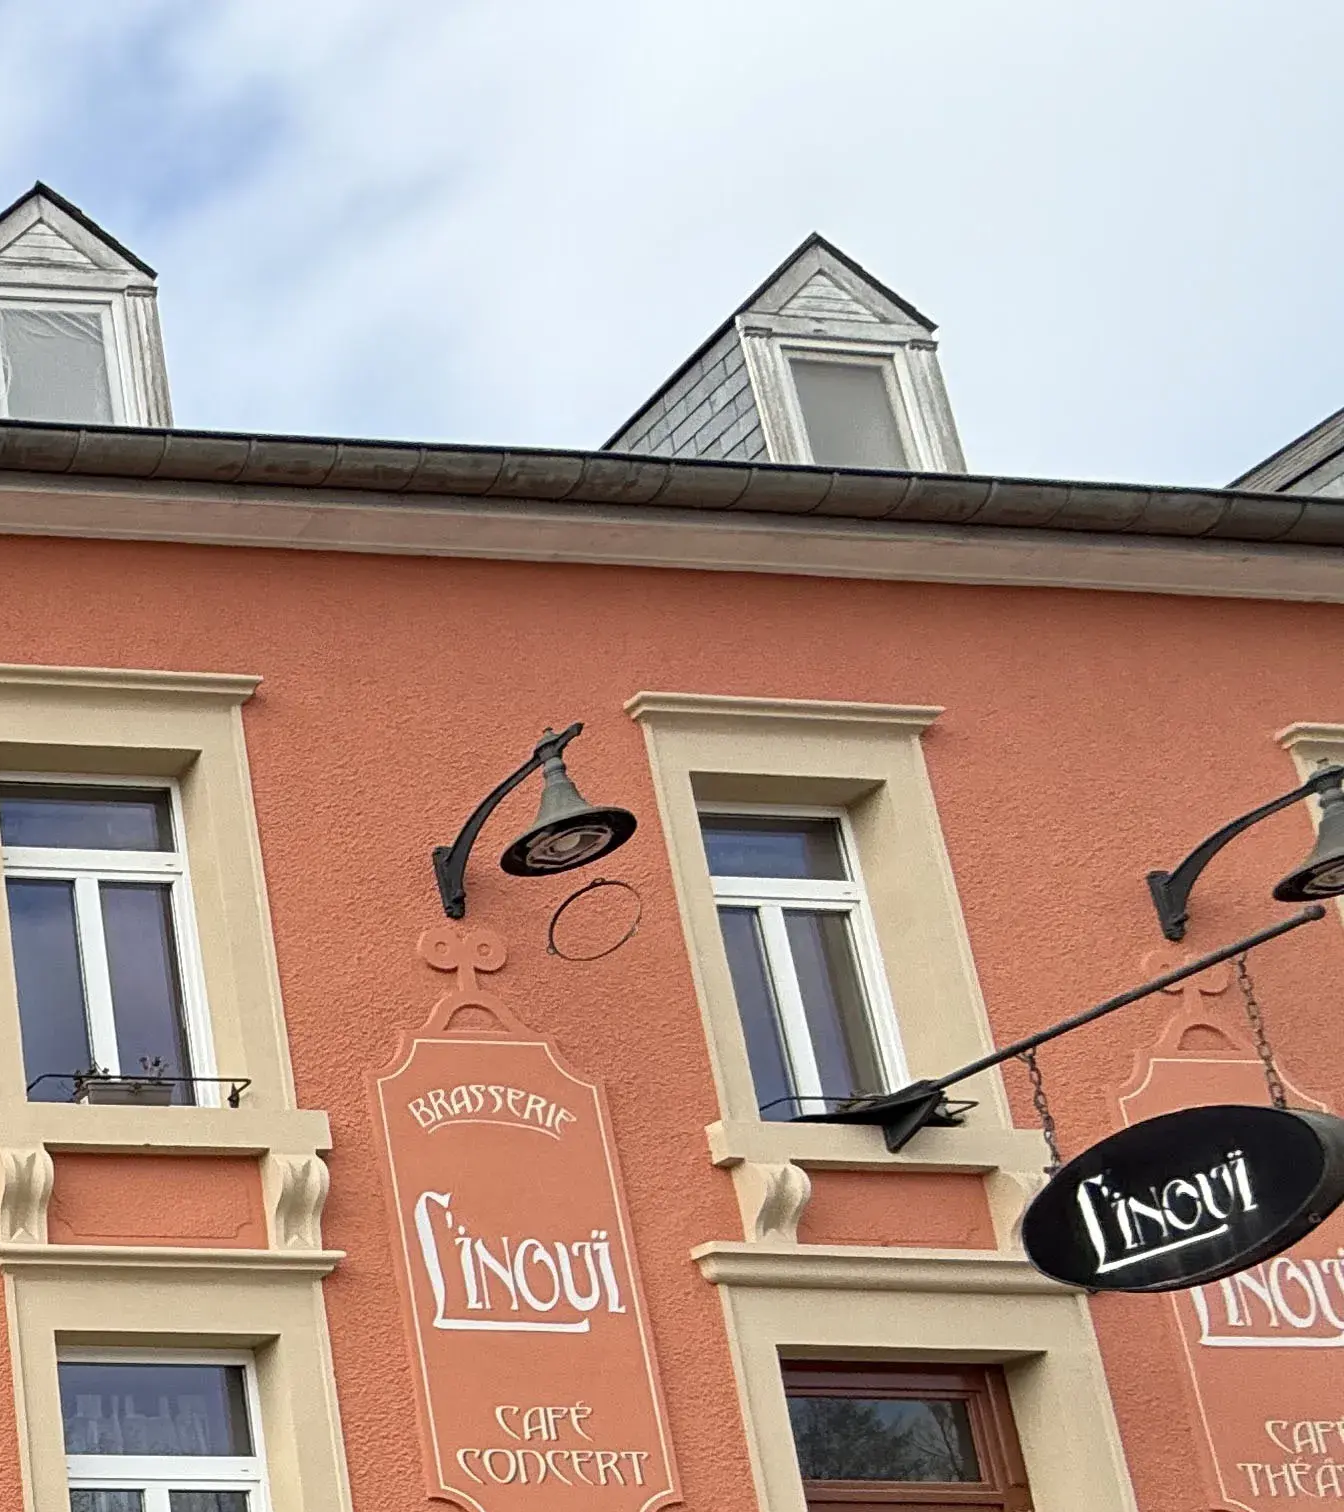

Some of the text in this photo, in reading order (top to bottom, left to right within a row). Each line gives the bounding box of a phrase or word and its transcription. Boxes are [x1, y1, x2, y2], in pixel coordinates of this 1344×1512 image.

[409, 1084, 578, 1136] BRASSERIE
[496, 1401, 595, 1442] CAFÉ
[456, 1447, 650, 1488] CONCERT
